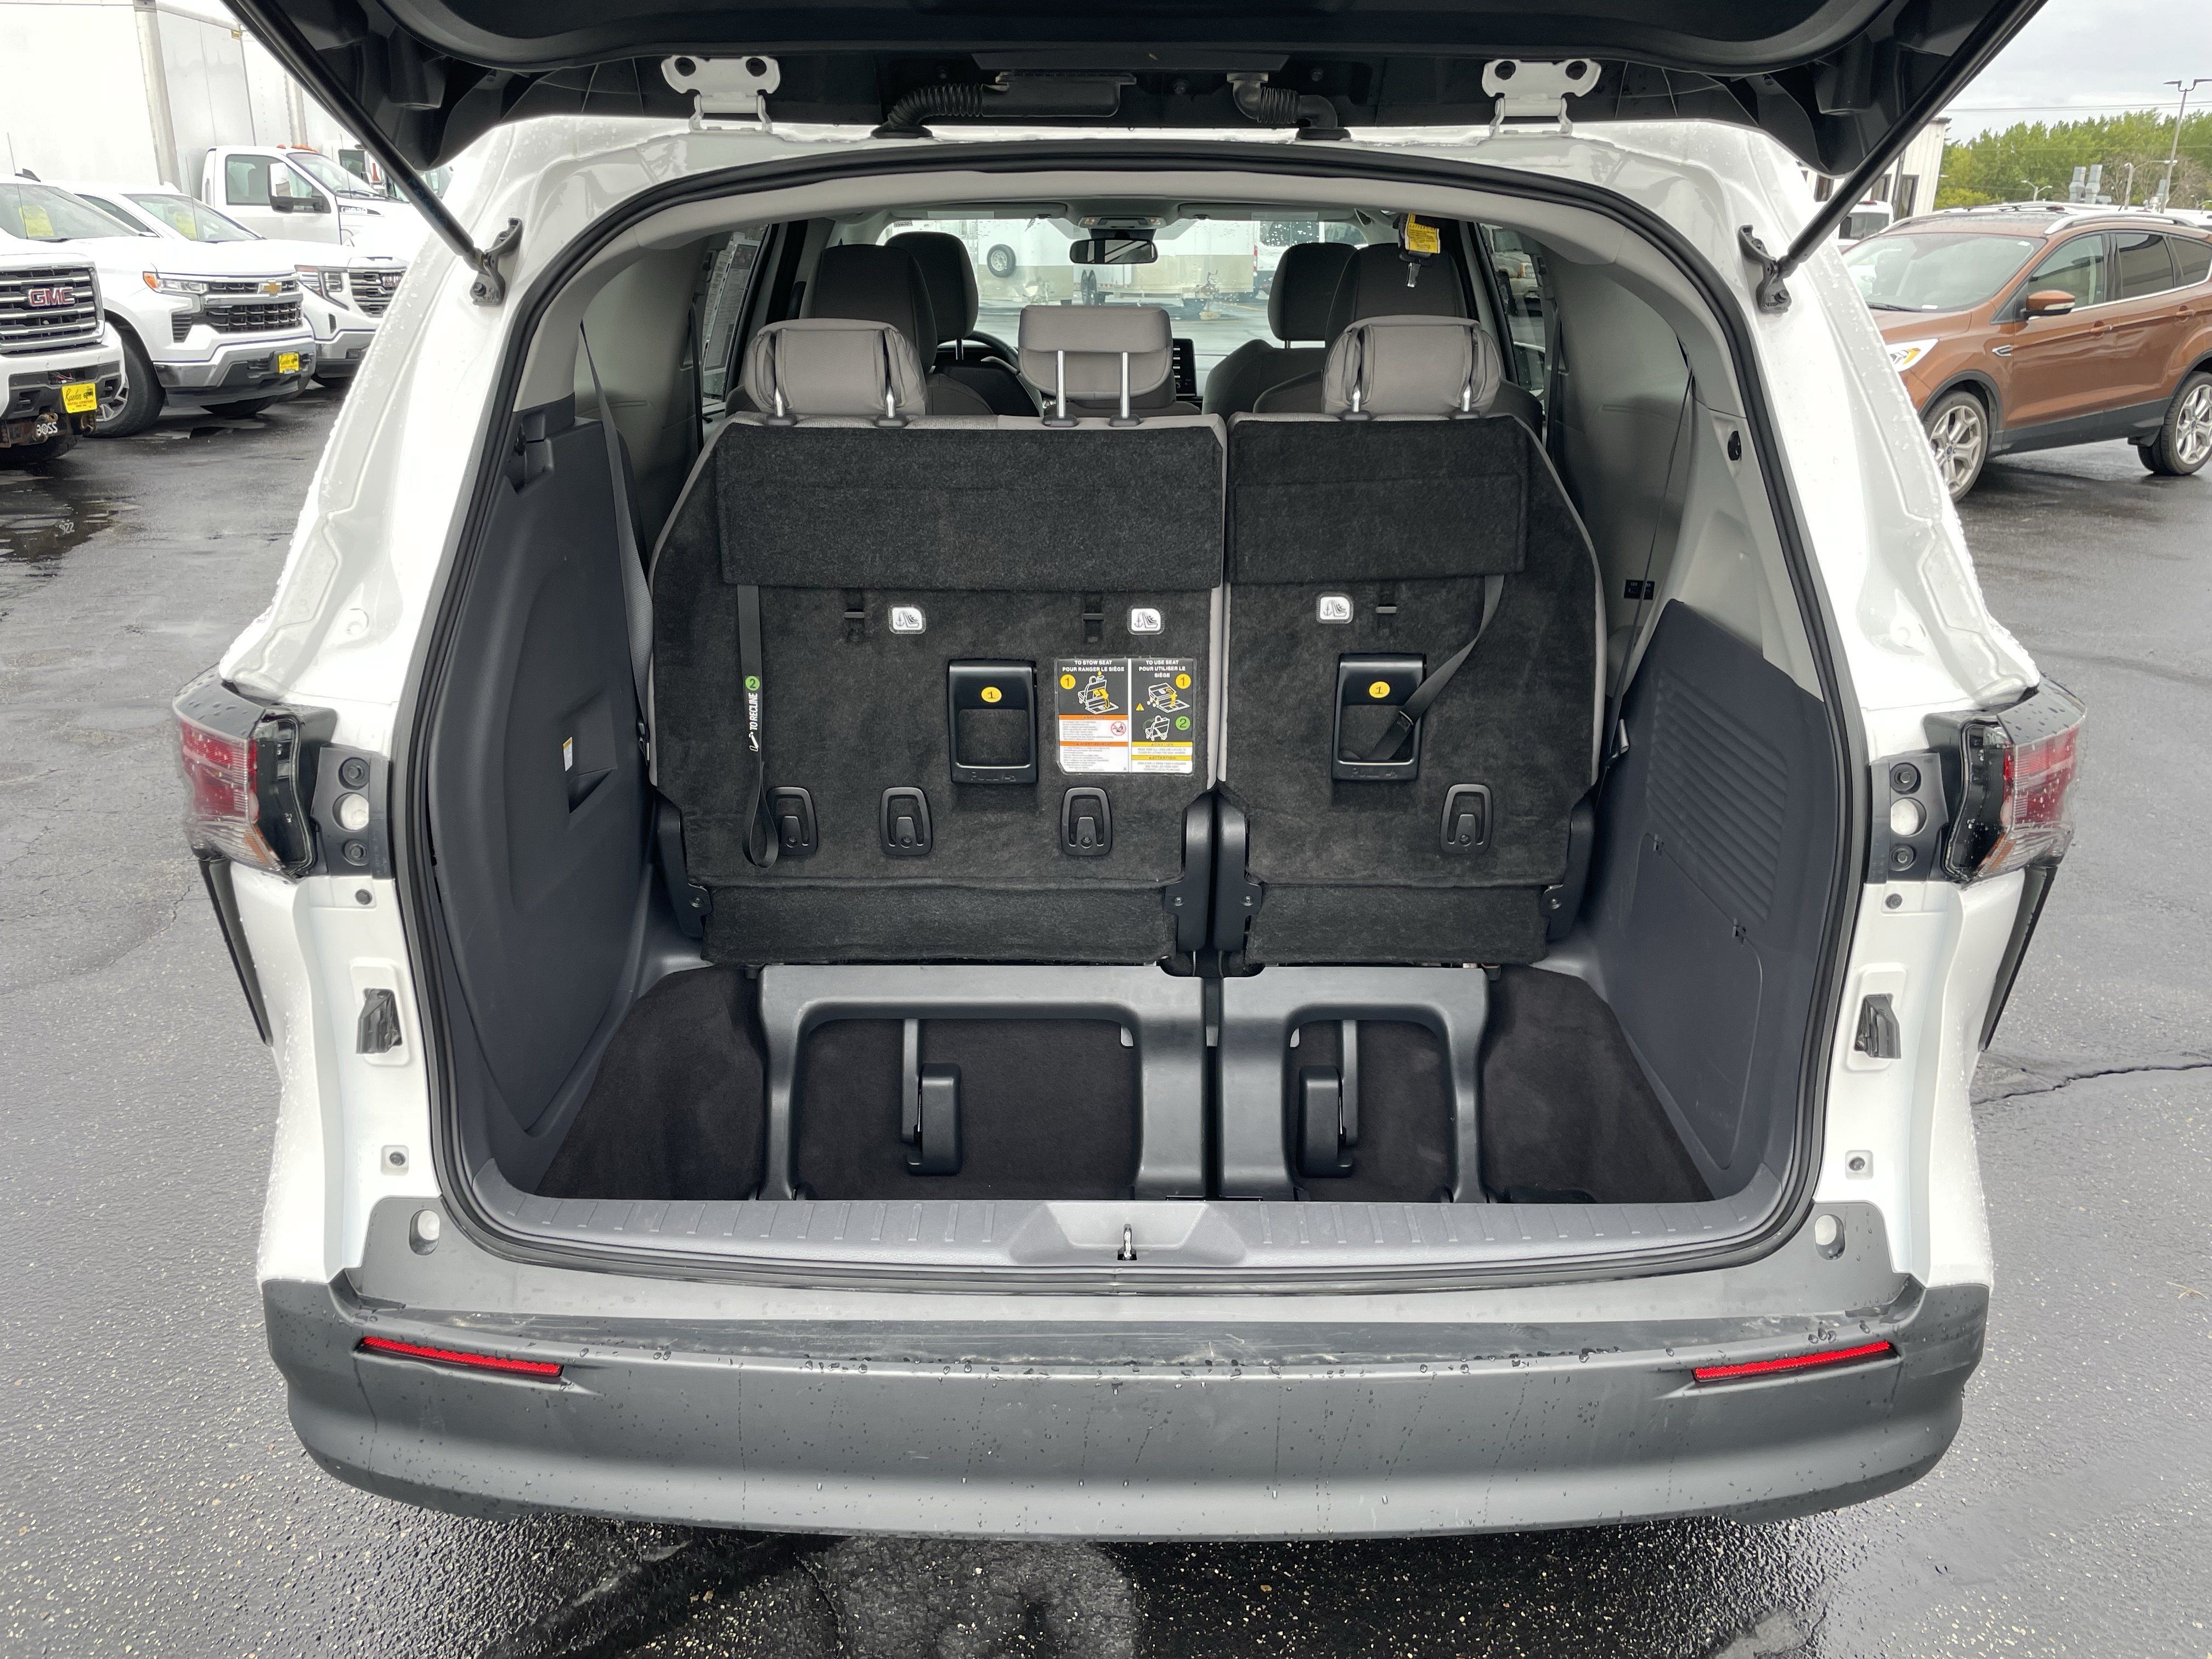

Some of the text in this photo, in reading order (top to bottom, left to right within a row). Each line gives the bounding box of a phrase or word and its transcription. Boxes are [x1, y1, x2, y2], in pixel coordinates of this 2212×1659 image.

[29, 286, 75, 307] GMC
[65, 389, 82, 402] Kuehn
[36, 421, 58, 436] BOSS
[749, 679, 756, 689] 2
[1065, 677, 1069, 687] 1
[1181, 676, 1185, 686] 1
[987, 691, 996, 699] 1
[748, 692, 758, 730] TO RECLINE
[1180, 718, 1187, 728] 2
